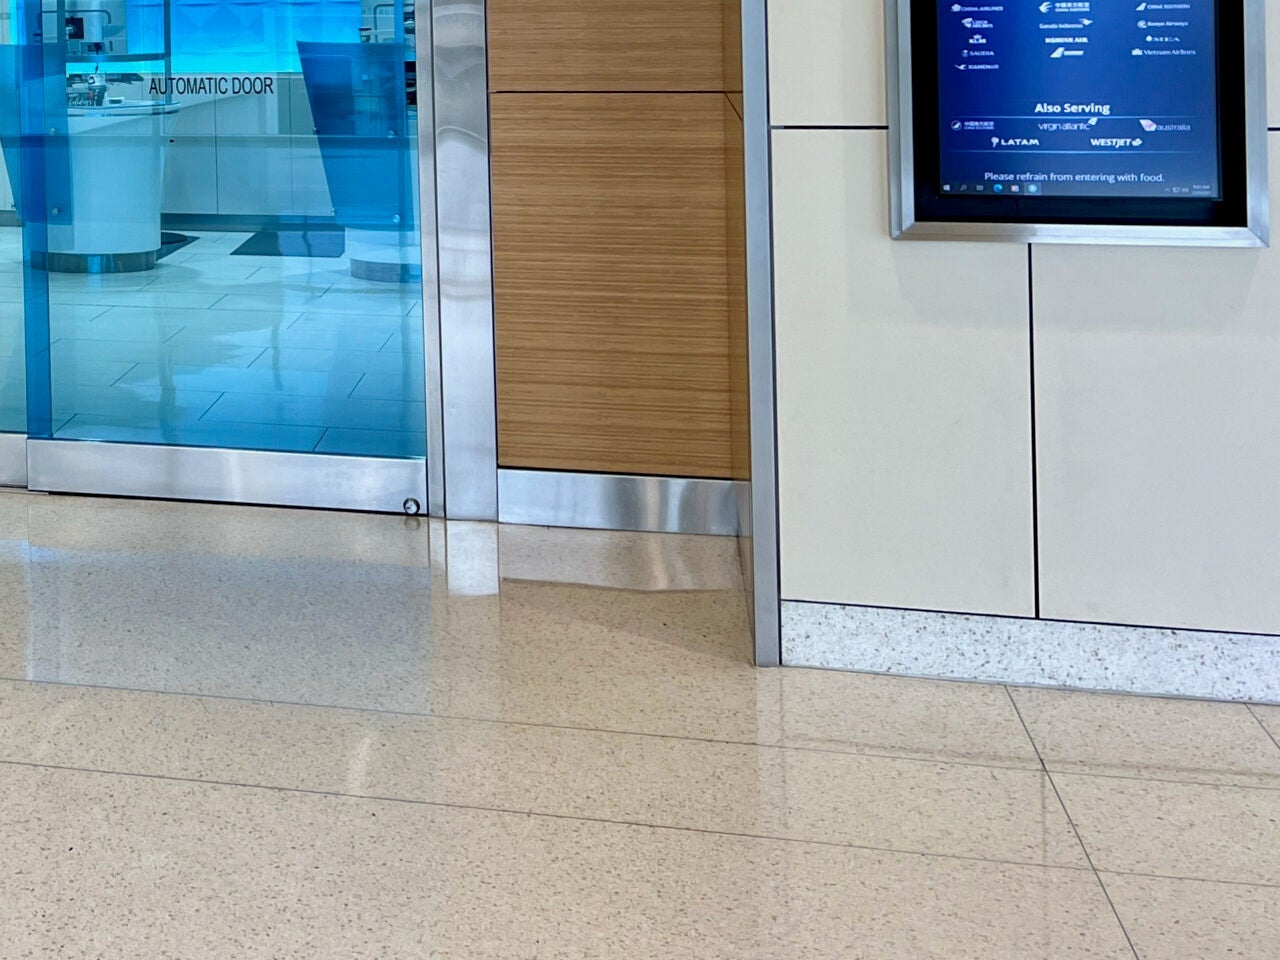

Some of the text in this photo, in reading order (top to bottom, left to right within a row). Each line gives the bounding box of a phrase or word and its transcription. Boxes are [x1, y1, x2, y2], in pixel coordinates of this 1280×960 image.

[149, 76, 274, 95] AUTOMATIC DOOR
[1034, 103, 1110, 115] Also Serving
[1090, 138, 1132, 149] WESTJET
[984, 172, 1165, 184] Please refrain from entering with food.
